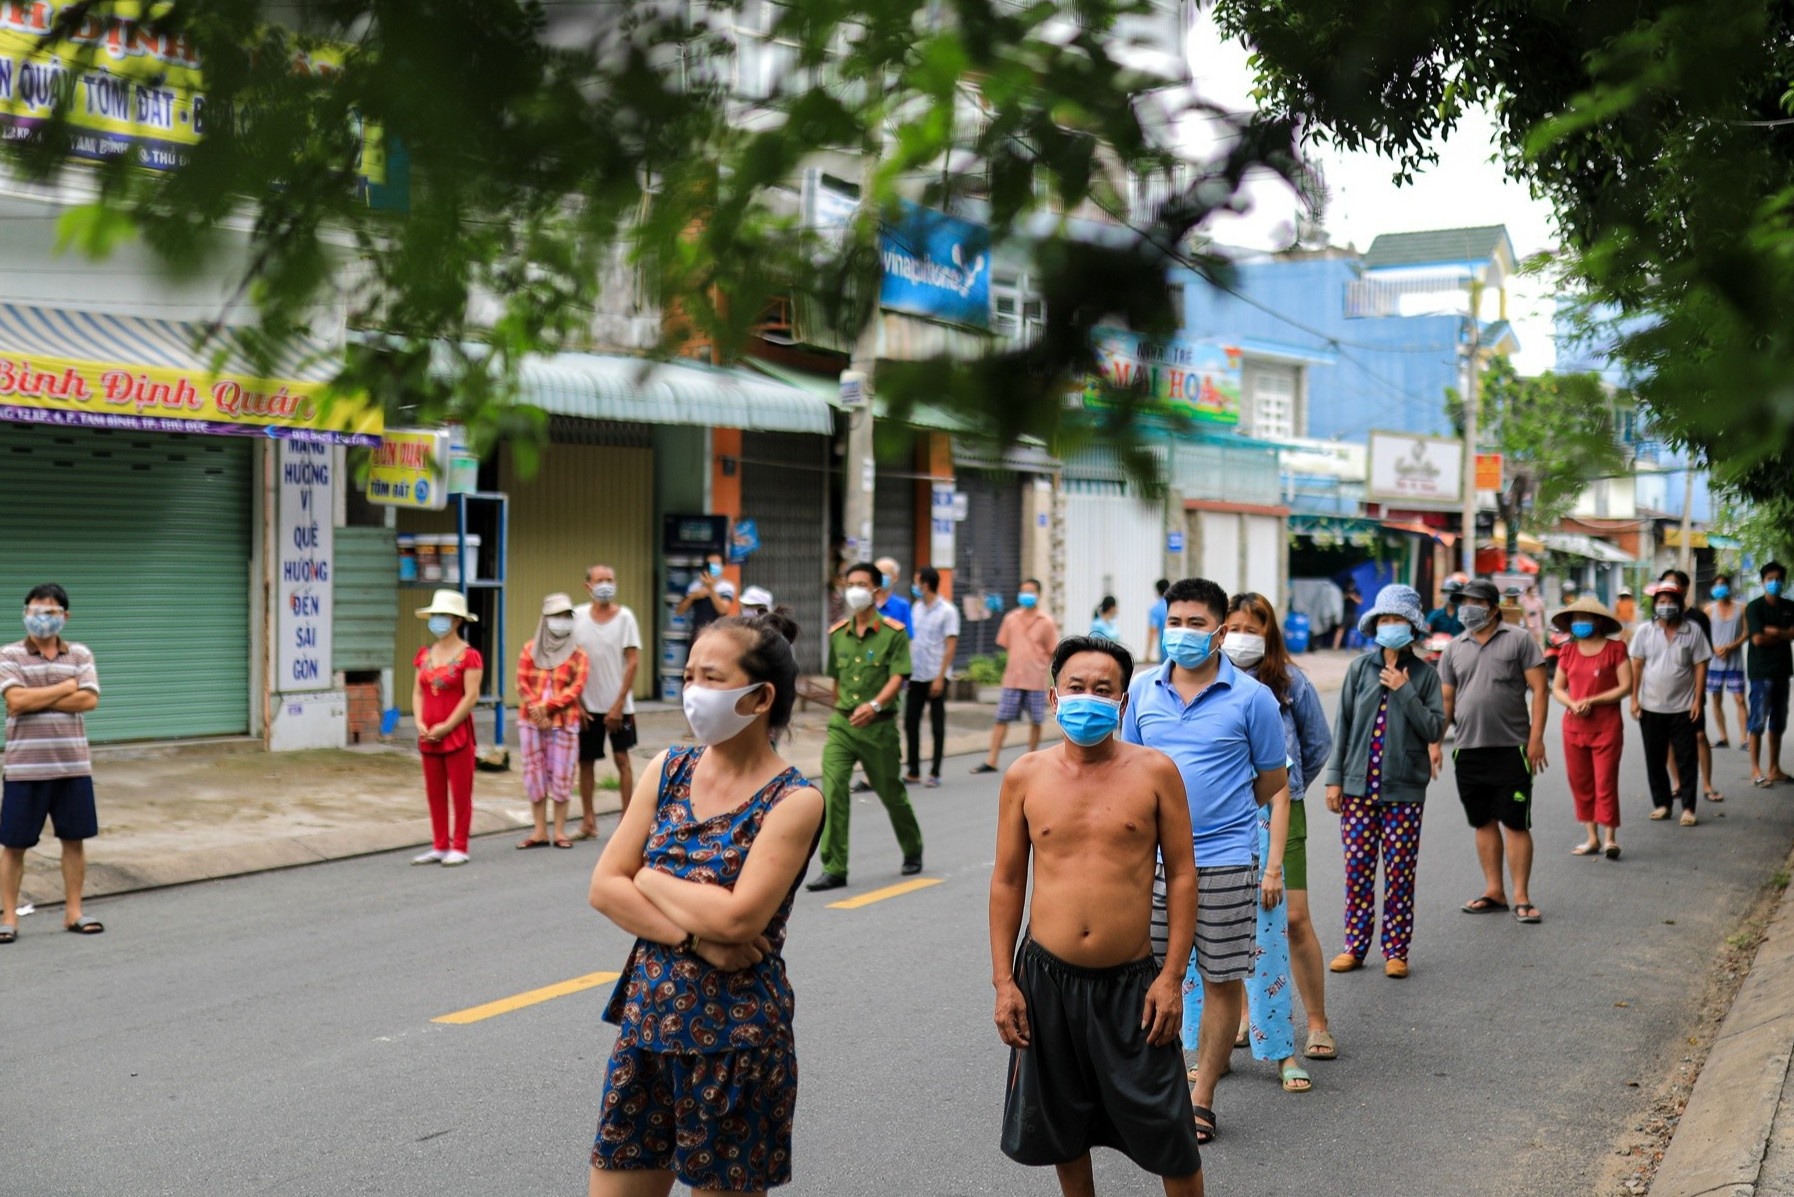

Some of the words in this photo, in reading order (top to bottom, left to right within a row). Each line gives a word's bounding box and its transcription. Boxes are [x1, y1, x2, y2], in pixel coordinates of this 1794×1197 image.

[0, 359, 91, 400] Bình
[101, 369, 203, 413] Định
[211, 379, 317, 420] Quán
[296, 620, 316, 648] SÀI
[293, 653, 318, 681] GÒN
